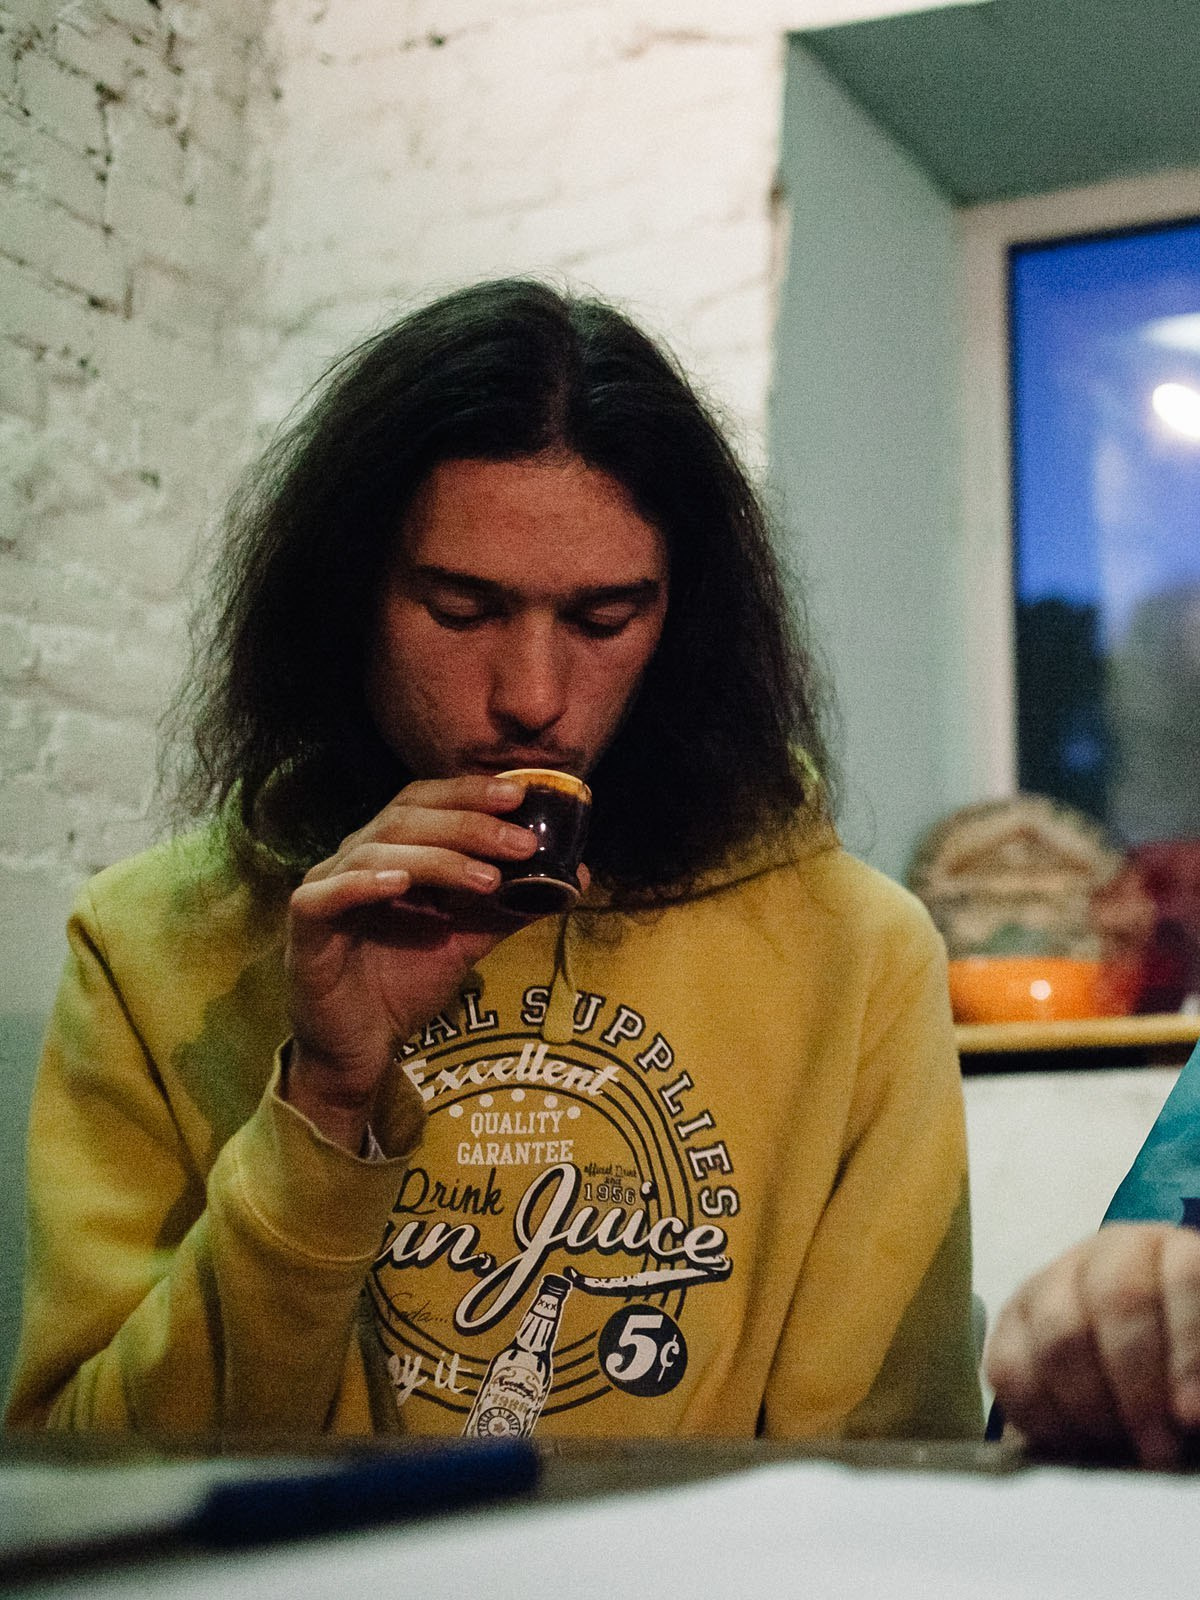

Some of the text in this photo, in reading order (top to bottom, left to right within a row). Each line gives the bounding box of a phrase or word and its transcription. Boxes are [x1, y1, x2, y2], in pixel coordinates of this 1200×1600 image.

[402, 1043, 620, 1101] Excellent
[394, 986, 741, 1218] AL SUPPLIES
[470, 1110, 565, 1136] QUALITY
[457, 1139, 575, 1166] GARANTEE
[392, 1168, 505, 1215] Drink
[583, 1182, 636, 1206] 1956
[453, 1162, 733, 1336] Juice
[434, 1351, 473, 1394] it
